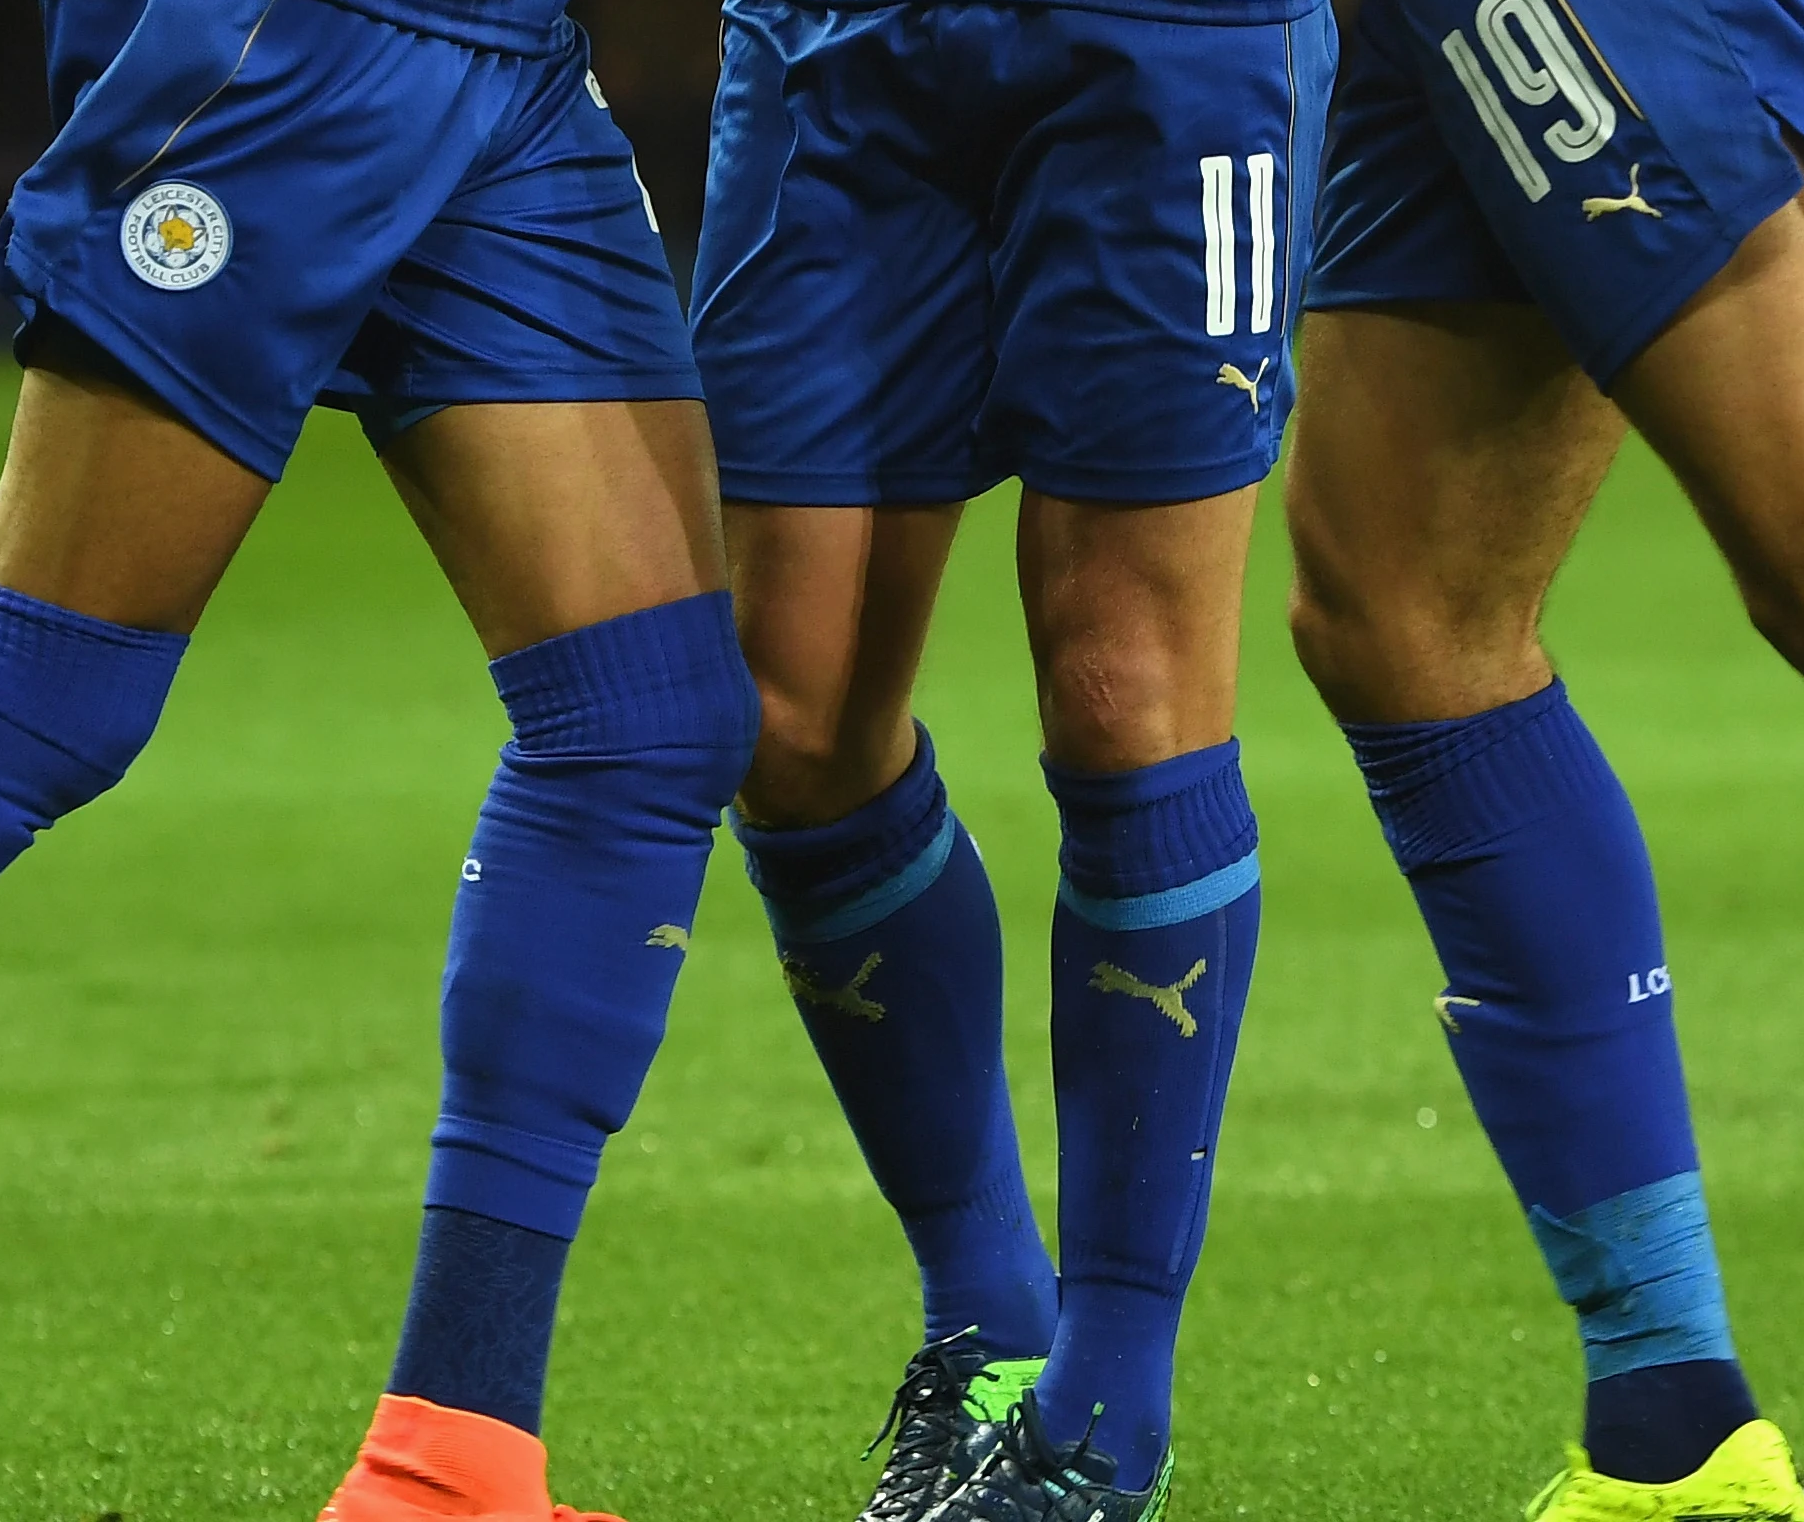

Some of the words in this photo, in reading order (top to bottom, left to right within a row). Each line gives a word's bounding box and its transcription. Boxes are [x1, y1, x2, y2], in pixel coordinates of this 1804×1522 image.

[127, 213, 167, 283] FOOTBALL
[170, 262, 211, 284] CLUB
[141, 189, 218, 226] LEICESTER
[211, 224, 224, 259] CITY
[1200, 152, 1275, 337] 11
